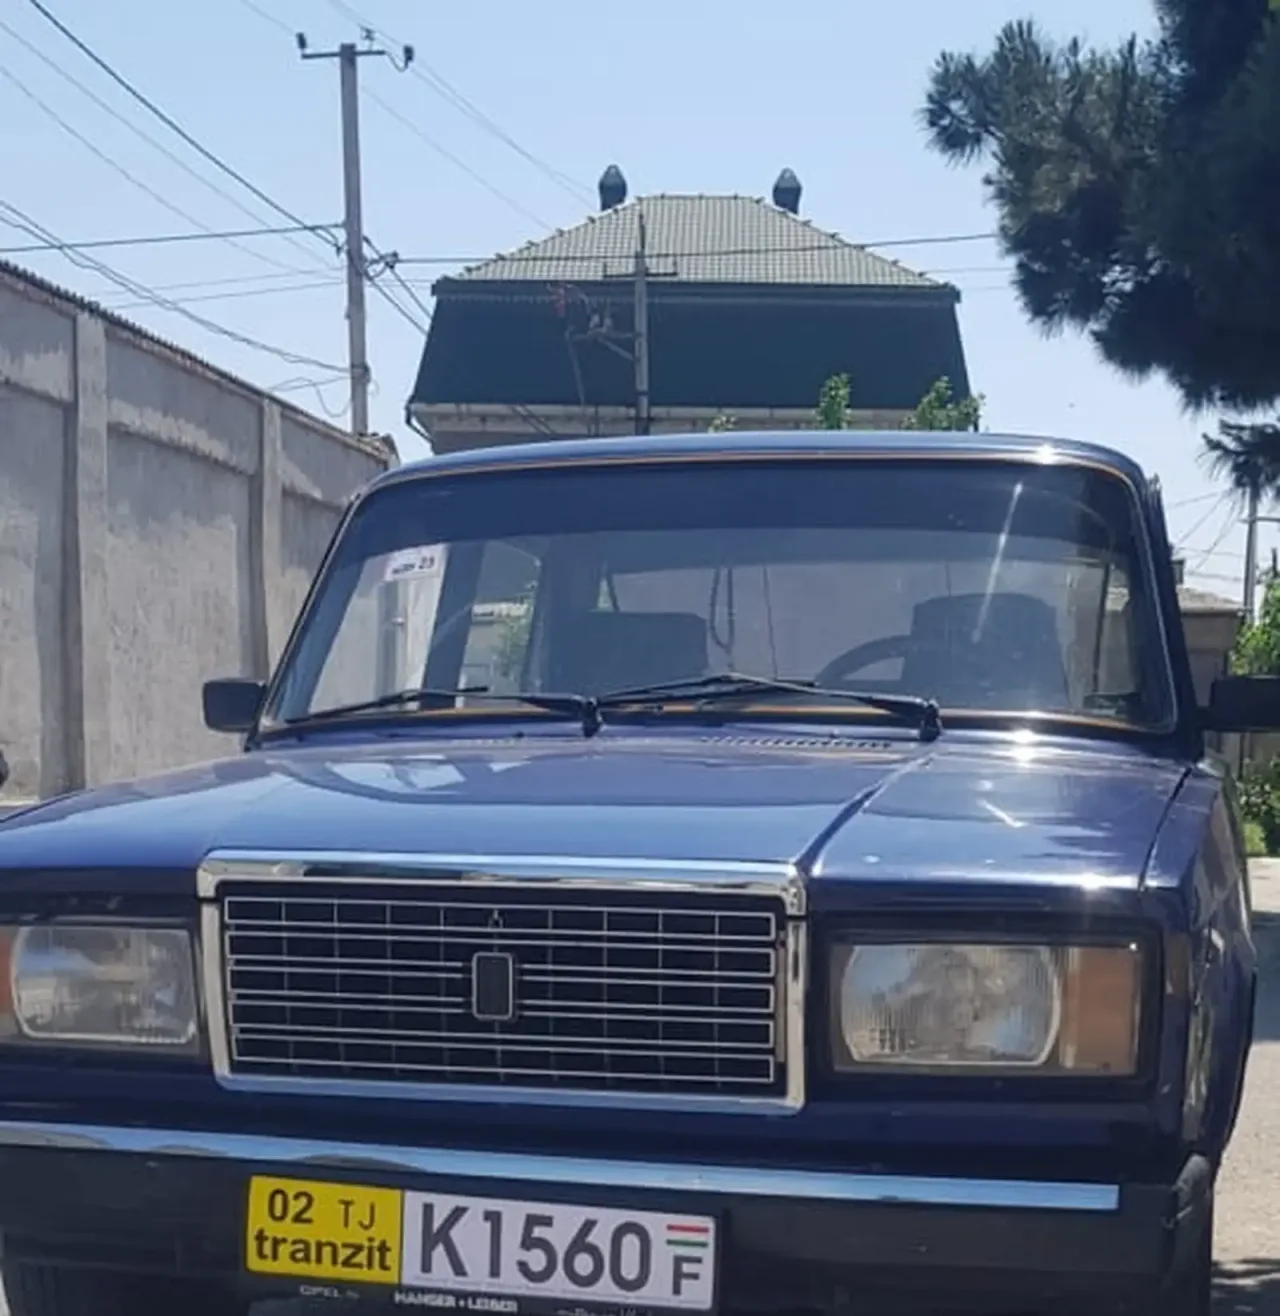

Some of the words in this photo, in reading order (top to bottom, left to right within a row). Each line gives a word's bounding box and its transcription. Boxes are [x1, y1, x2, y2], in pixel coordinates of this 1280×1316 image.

[268, 1188, 315, 1225] 02
[338, 1199, 376, 1231] TJ
[254, 1227, 392, 1271] tranzit
[421, 1202, 652, 1293] K1560
[672, 1255, 704, 1296] F
